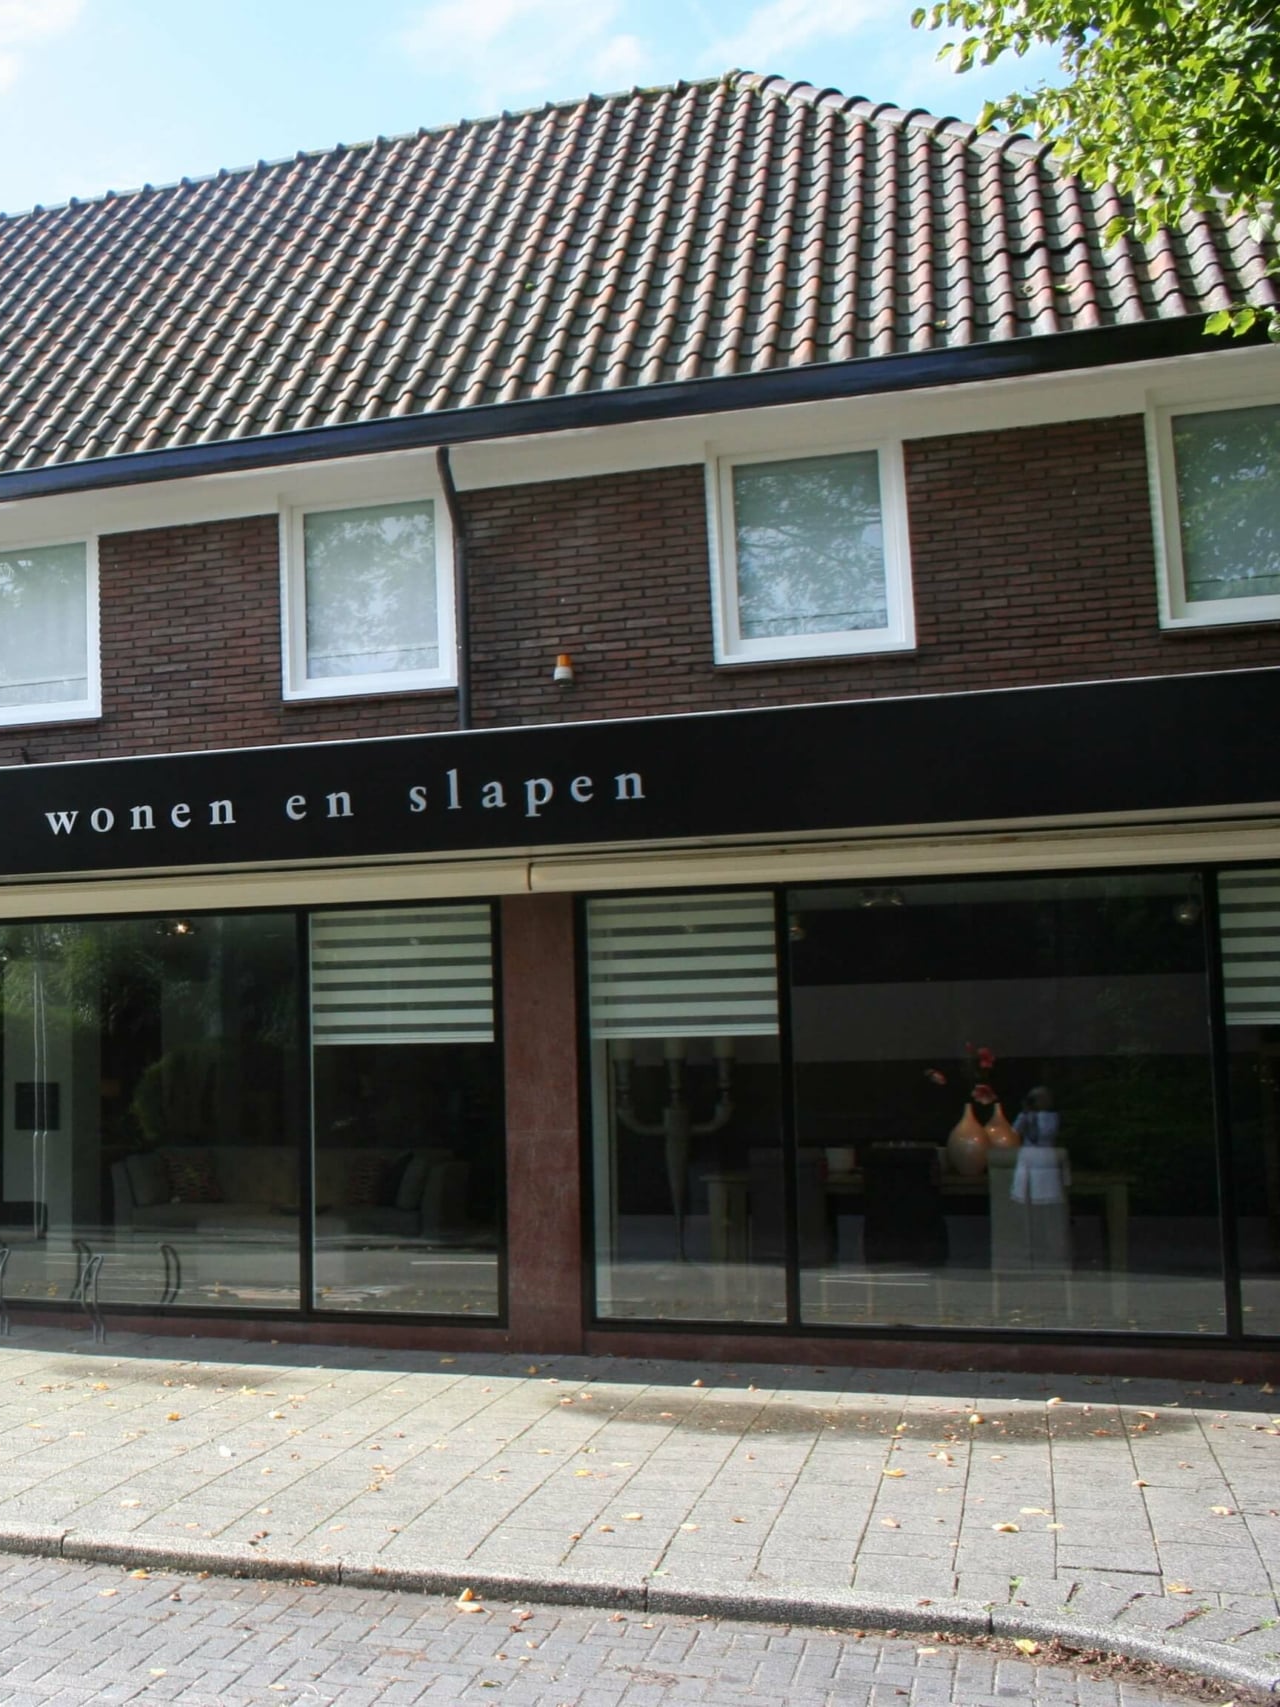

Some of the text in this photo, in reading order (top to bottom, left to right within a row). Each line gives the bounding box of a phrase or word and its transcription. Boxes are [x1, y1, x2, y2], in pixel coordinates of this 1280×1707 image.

[46, 769, 646, 835] wonen en slapen
